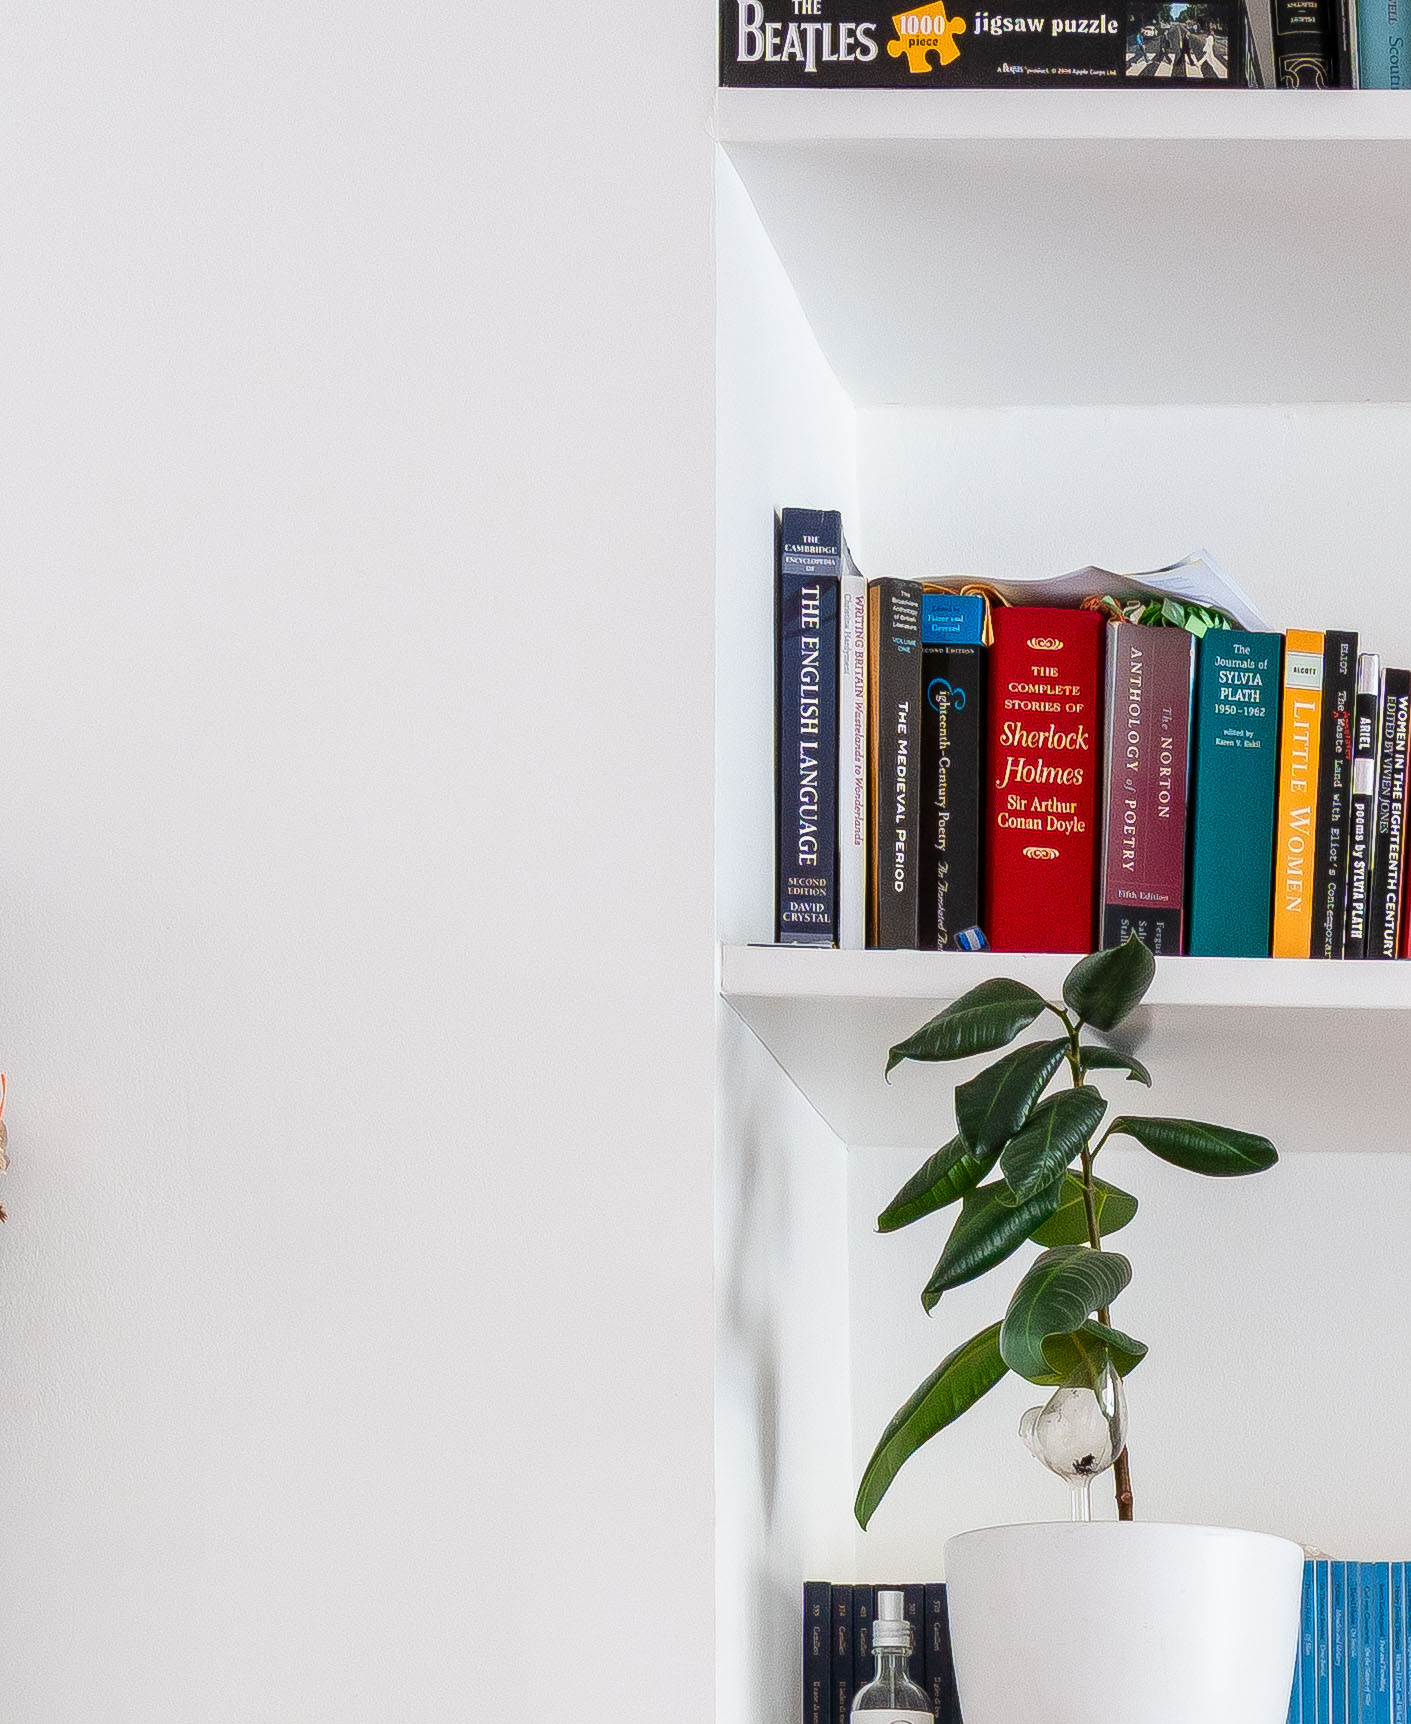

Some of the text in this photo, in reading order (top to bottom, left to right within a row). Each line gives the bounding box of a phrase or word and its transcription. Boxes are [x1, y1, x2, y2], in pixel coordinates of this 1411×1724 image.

[899, 16, 945, 36] 1000
[974, 13, 1118, 36] jigsaw puzzle
[737, 1, 878, 72] BEATLES
[909, 36, 939, 48] piece
[1233, 645, 1250, 654] The
[1031, 667, 1058, 676] THE
[1214, 657, 1267, 669] Journals of
[1218, 671, 1263, 686] SYLVIA
[1008, 682, 1080, 695] COMPLETE
[1220, 687, 1260, 701] PLATH
[1005, 700, 1084, 713] STORIES OF
[798, 586, 819, 866] THE ENGLISH LANGUAGE
[1000, 722, 1088, 750] Sherlock
[1122, 647, 1142, 871] ANTHOLOGY of POETRY
[1158, 708, 1172, 818] The NORTON
[996, 757, 1084, 788] Holmes
[894, 702, 908, 892] THE MEDIEVAL PERIOD
[1006, 795, 1077, 813] Sir Arthur
[1286, 700, 1315, 912] LITTLE WOMEN
[997, 812, 1086, 833] Conan Doyle
[1351, 717, 1371, 938] ARIEL poems by SYLVIA PLATH
[1383, 696, 1409, 956] WOMEN IN THE EIGHTEENTH CENTURY
[788, 877, 827, 886] SECOND
[788, 887, 826, 896] EDITION
[790, 902, 825, 912] DAVID
[783, 912, 831, 922] CRYSTAL
